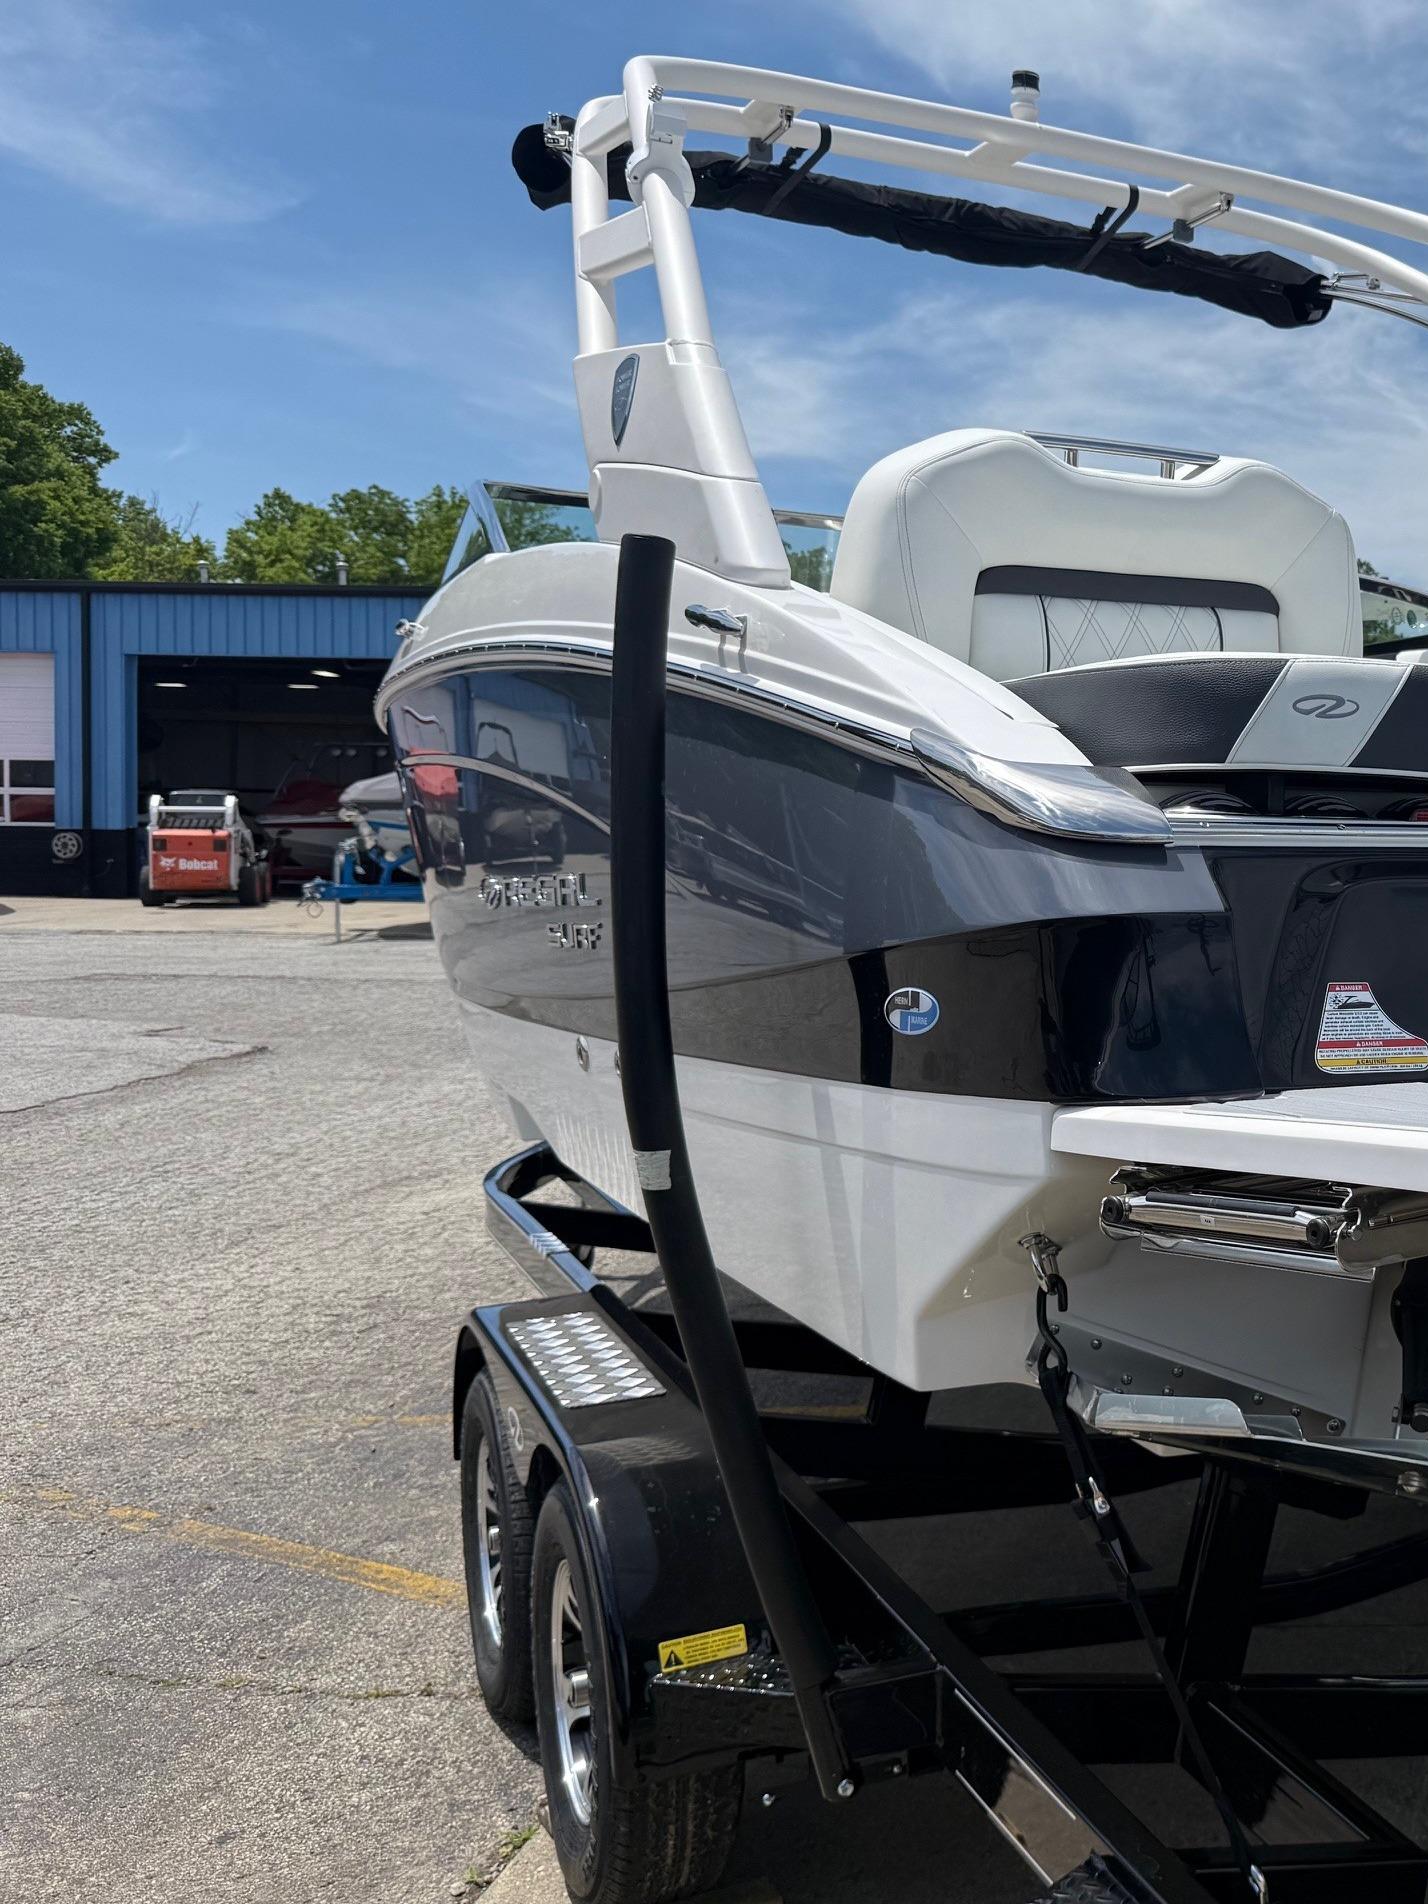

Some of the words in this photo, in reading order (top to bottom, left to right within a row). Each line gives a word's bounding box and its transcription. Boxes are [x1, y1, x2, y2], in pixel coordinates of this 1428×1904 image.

[178, 858, 219, 871] Bobcat
[503, 872, 603, 907] REGAL
[548, 922, 603, 950] SURF
